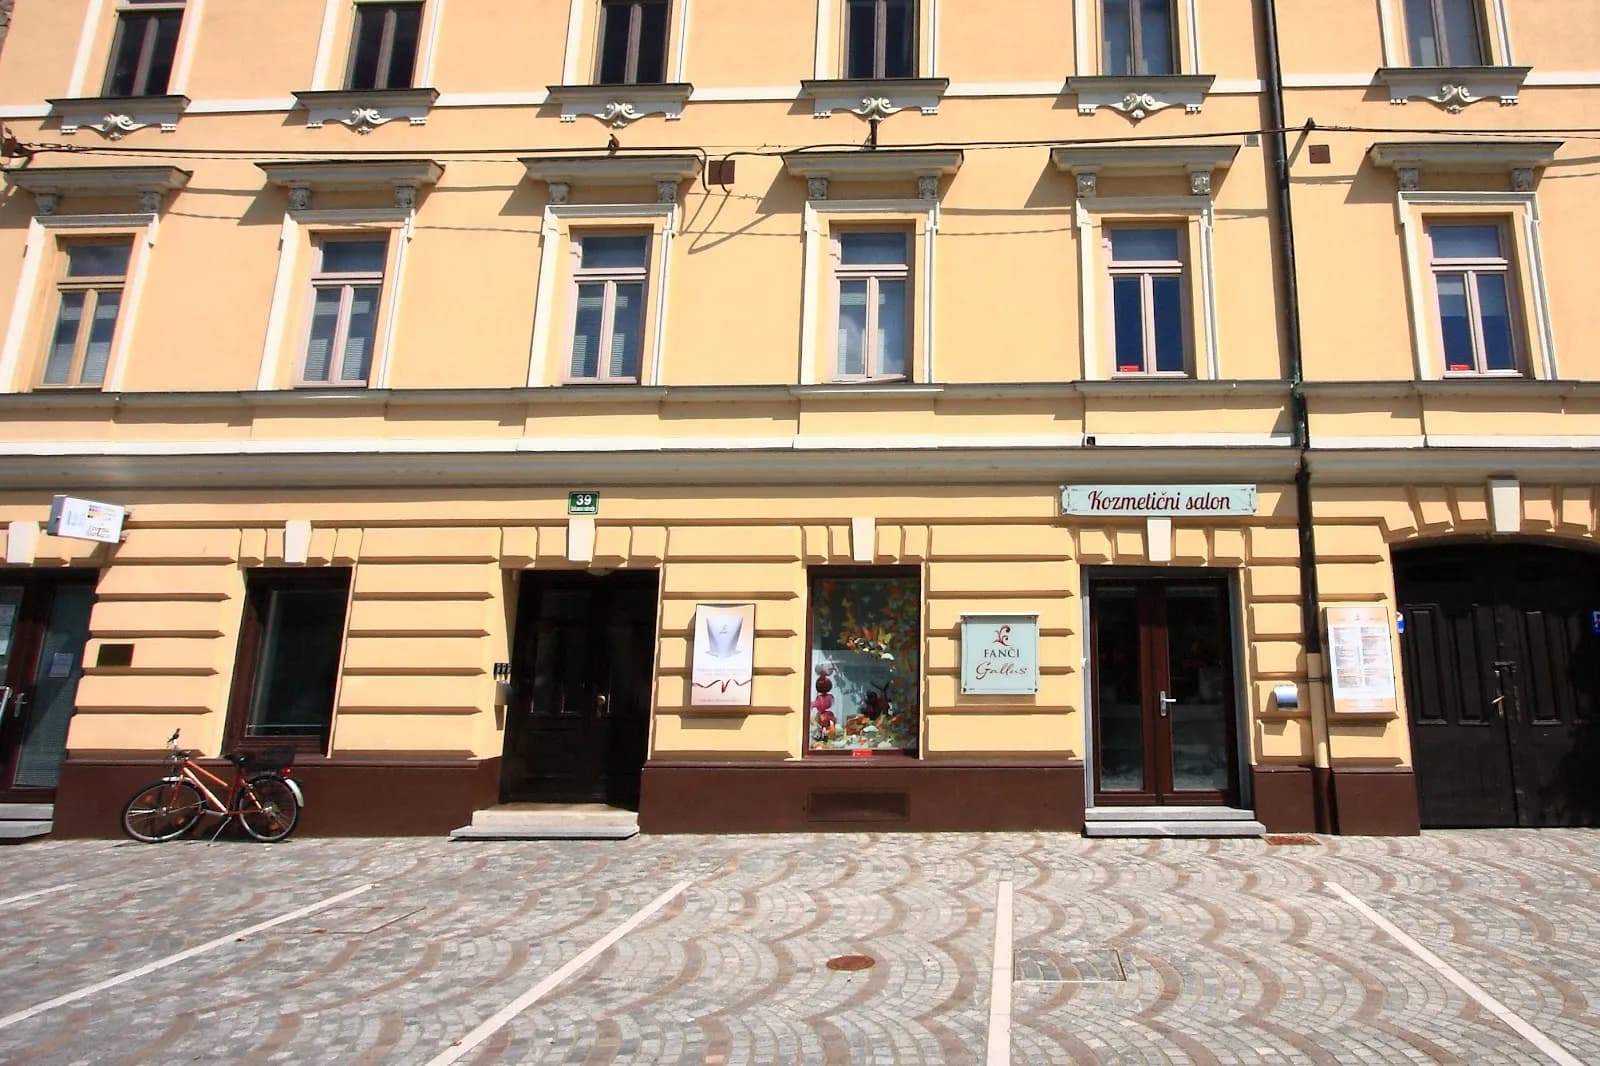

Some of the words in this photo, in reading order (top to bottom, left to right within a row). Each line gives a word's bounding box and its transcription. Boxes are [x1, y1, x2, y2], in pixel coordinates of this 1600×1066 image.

[576, 494, 592, 506] 39
[1088, 490, 1180, 511] Kozmetični
[1185, 491, 1231, 510] salon
[984, 647, 1020, 658] FANČI
[976, 661, 1028, 680] Gallus
